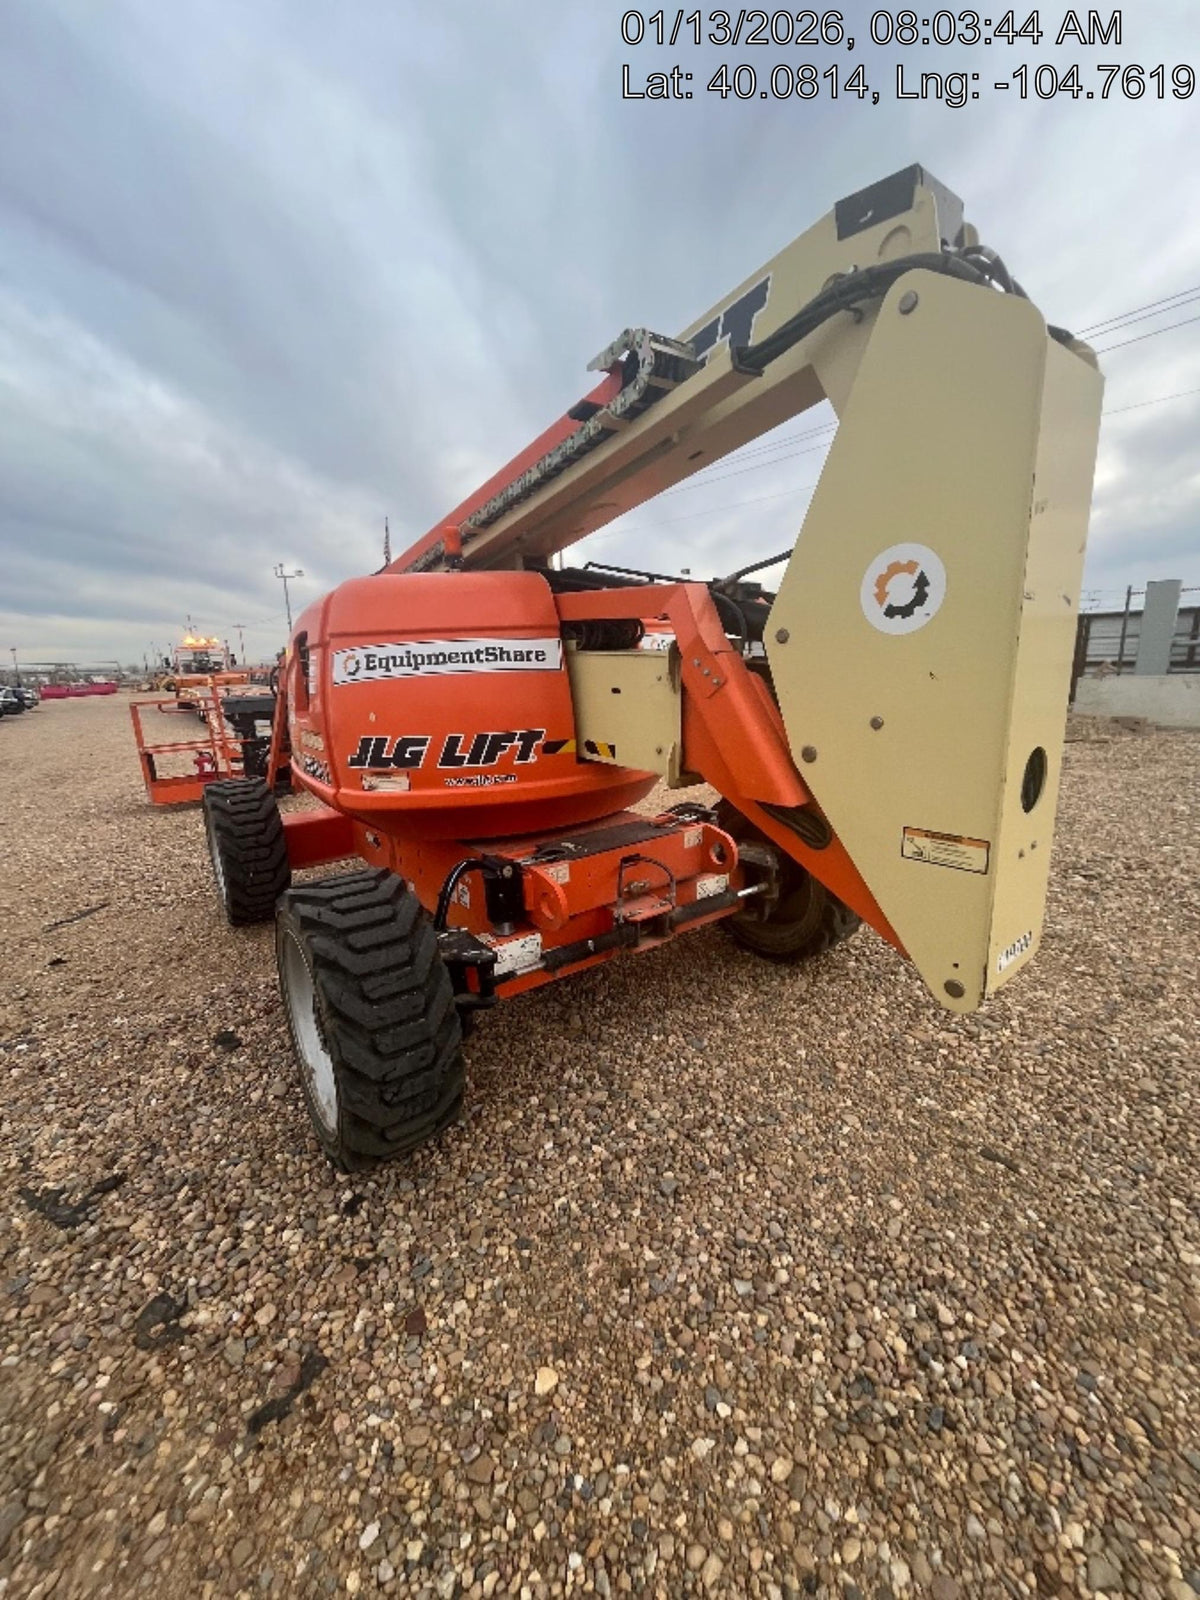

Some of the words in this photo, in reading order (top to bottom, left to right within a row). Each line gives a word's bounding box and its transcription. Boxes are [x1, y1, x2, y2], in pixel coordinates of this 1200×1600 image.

[364, 646, 547, 672] EquipmentShare
[348, 735, 432, 768] JLG
[437, 728, 547, 768] LIFT
